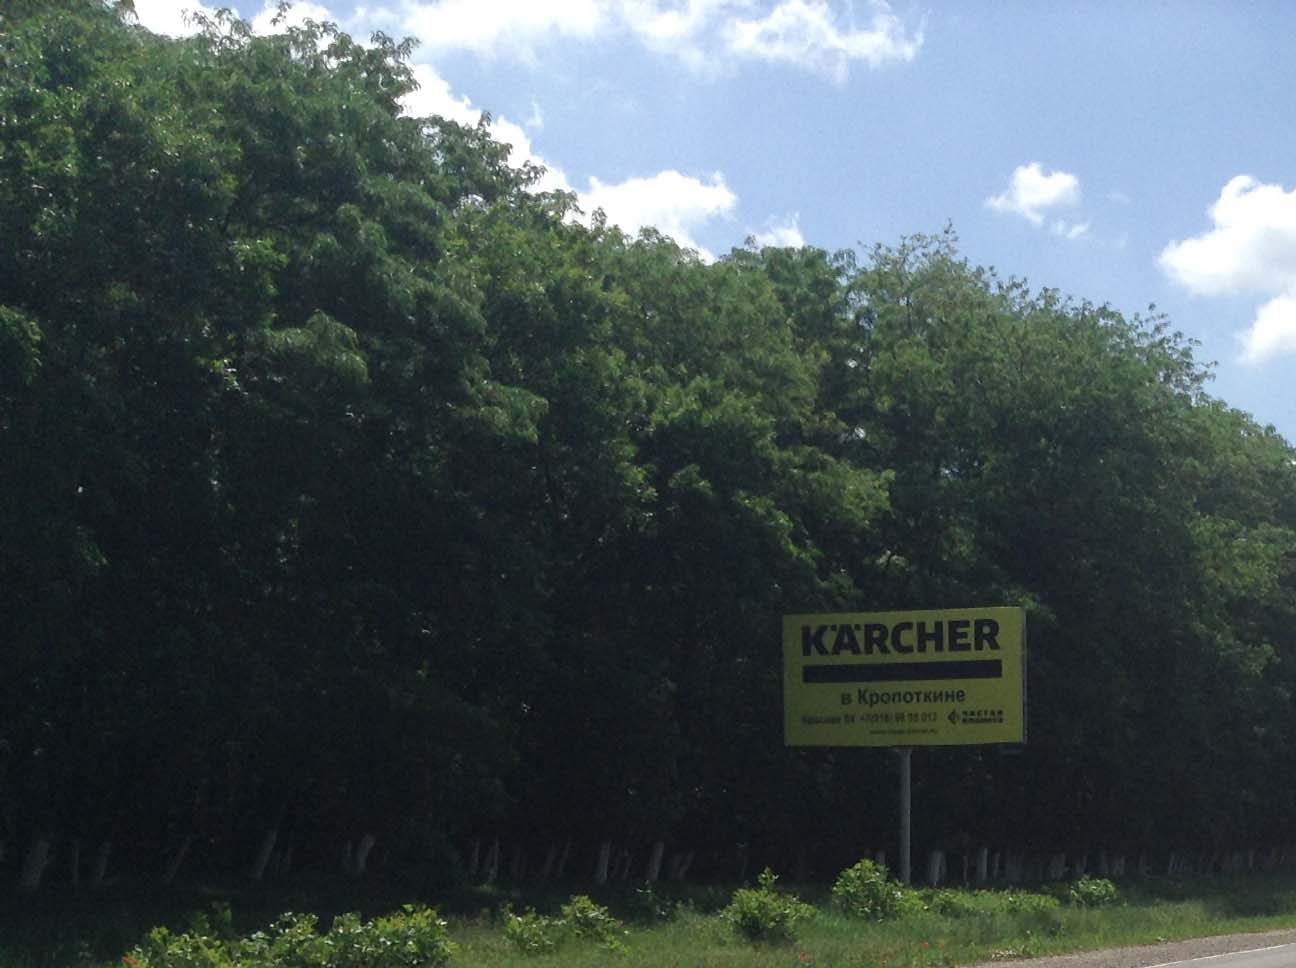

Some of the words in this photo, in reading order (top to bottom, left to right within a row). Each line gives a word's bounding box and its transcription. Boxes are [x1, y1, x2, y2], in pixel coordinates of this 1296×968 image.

[802, 618, 1000, 657] KÄRCHER
[841, 693, 852, 705] в
[857, 688, 966, 708] Кропоткине
